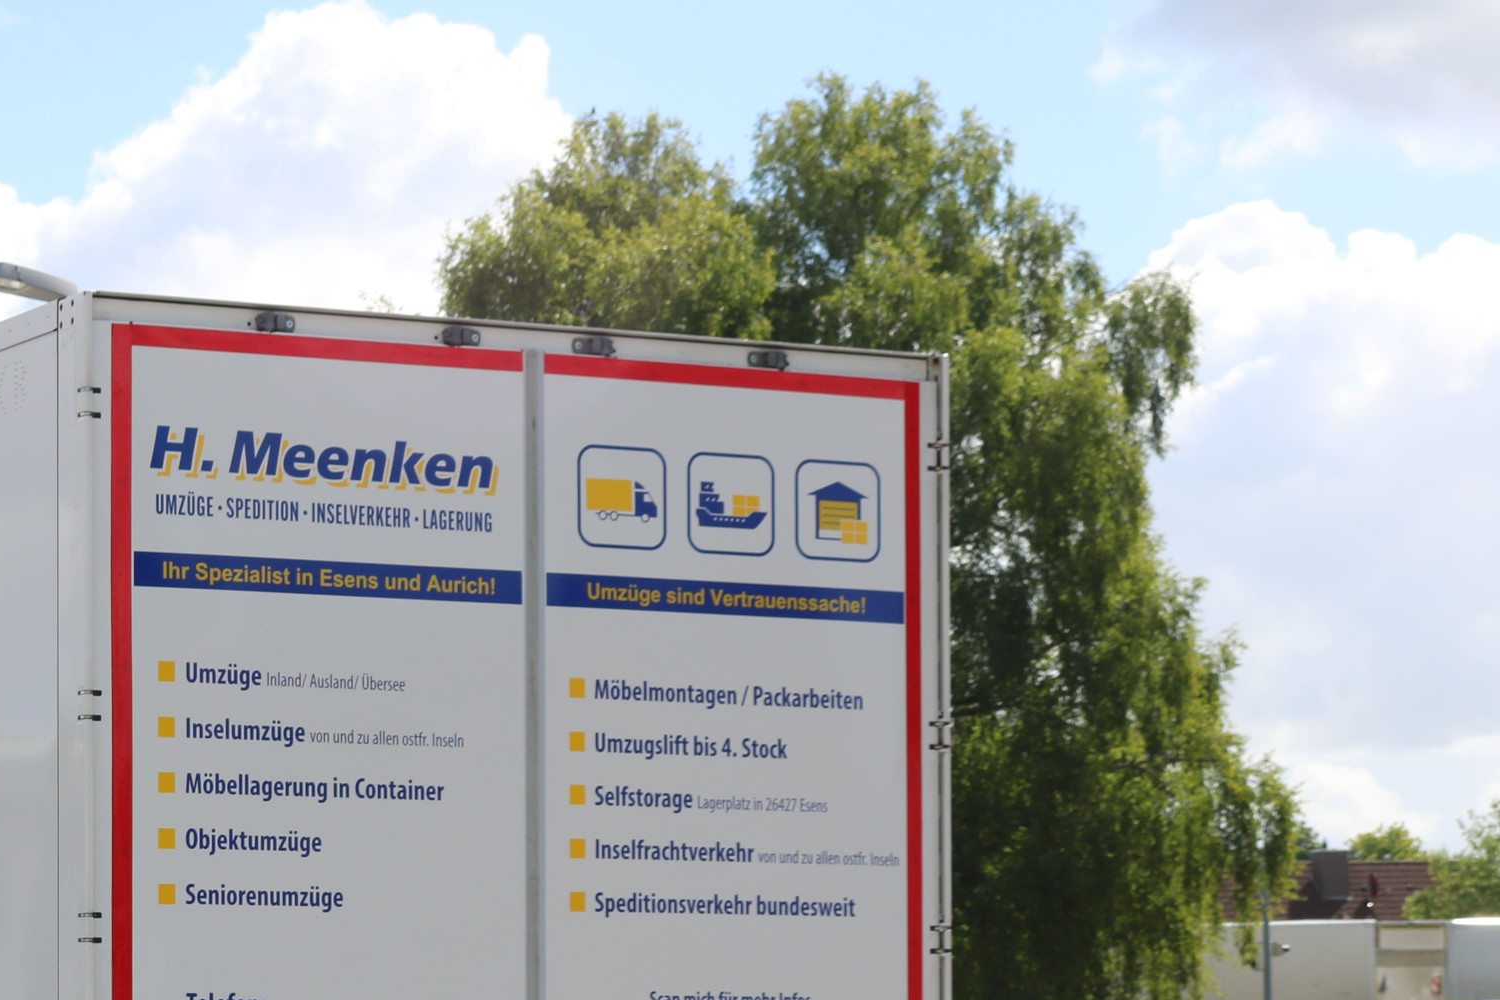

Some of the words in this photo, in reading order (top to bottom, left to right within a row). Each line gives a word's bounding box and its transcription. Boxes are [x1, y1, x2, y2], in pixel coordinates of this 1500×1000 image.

[150, 425, 217, 478] H.
[229, 430, 499, 496] Meenken
[155, 493, 214, 517] UMZÜGE
[226, 497, 299, 521] SPEDITION
[311, 506, 410, 528] INSELVERKEHR
[422, 508, 492, 532] LAGERUNG
[162, 561, 189, 580] Ihr
[195, 562, 290, 588] Spezialist
[296, 567, 313, 586] in
[320, 568, 379, 589] Esens
[385, 574, 421, 591] und
[426, 575, 495, 595] Aurich!
[587, 582, 661, 604] Umzüge
[666, 586, 705, 606] sind
[710, 588, 866, 614] Vertrauenssache!
[185, 662, 262, 690] Umzüge
[266, 671, 307, 689] Inland/
[310, 674, 359, 691] Ausland/
[361, 673, 406, 692] Übersee
[594, 679, 737, 709] Möbelmontagen
[753, 686, 864, 710] Packarbeiten
[185, 717, 305, 747] Inselumzüge
[310, 731, 330, 743] von
[333, 730, 354, 744] und
[357, 733, 369, 745] zu
[372, 730, 399, 746] allen
[402, 731, 429, 747] ostfr.
[432, 733, 465, 748] Inseln
[595, 733, 689, 759] Umzugslift
[694, 736, 717, 757] bis
[721, 737, 737, 758] 4.
[741, 738, 787, 759] Stock
[185, 773, 327, 803] Möbellagerung
[333, 778, 350, 798] in
[355, 778, 445, 801] Container
[594, 786, 693, 813] Selfstorage
[697, 795, 751, 811] Lagerplatz
[753, 796, 763, 810] in
[765, 797, 797, 811] 26427
[800, 798, 828, 813] Esens
[185, 828, 322, 858] Objektumzüge
[595, 839, 754, 863] Inselfrachtverkehr
[758, 851, 777, 864] von
[780, 850, 799, 864] und
[802, 853, 813, 865] zu
[815, 851, 840, 865] allen
[843, 851, 868, 866] ostfr.
[870, 852, 899, 867] Inseln
[185, 883, 344, 913] Seniorenumzüge
[594, 892, 752, 917] Speditionsverkehr
[756, 895, 855, 917] bundesweit
